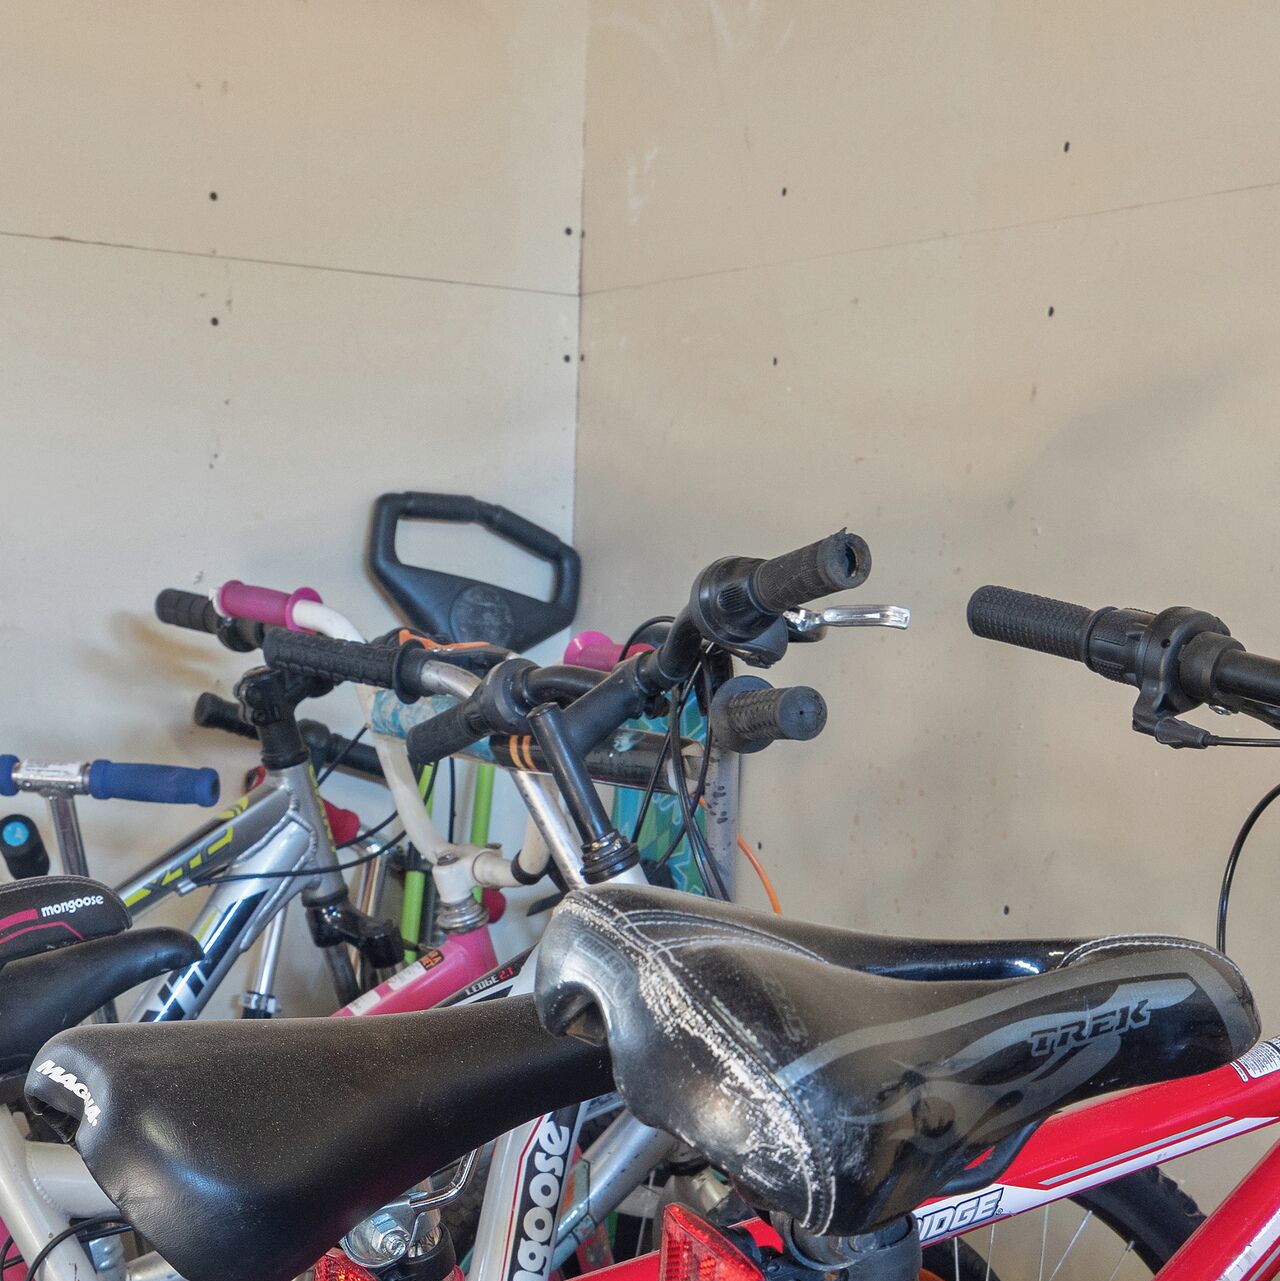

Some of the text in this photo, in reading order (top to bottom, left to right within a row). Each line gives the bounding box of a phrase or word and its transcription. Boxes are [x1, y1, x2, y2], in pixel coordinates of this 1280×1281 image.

[41, 895, 104, 917] mongoose
[464, 976, 500, 996] LEDGE
[1029, 999, 1151, 1057] TREK
